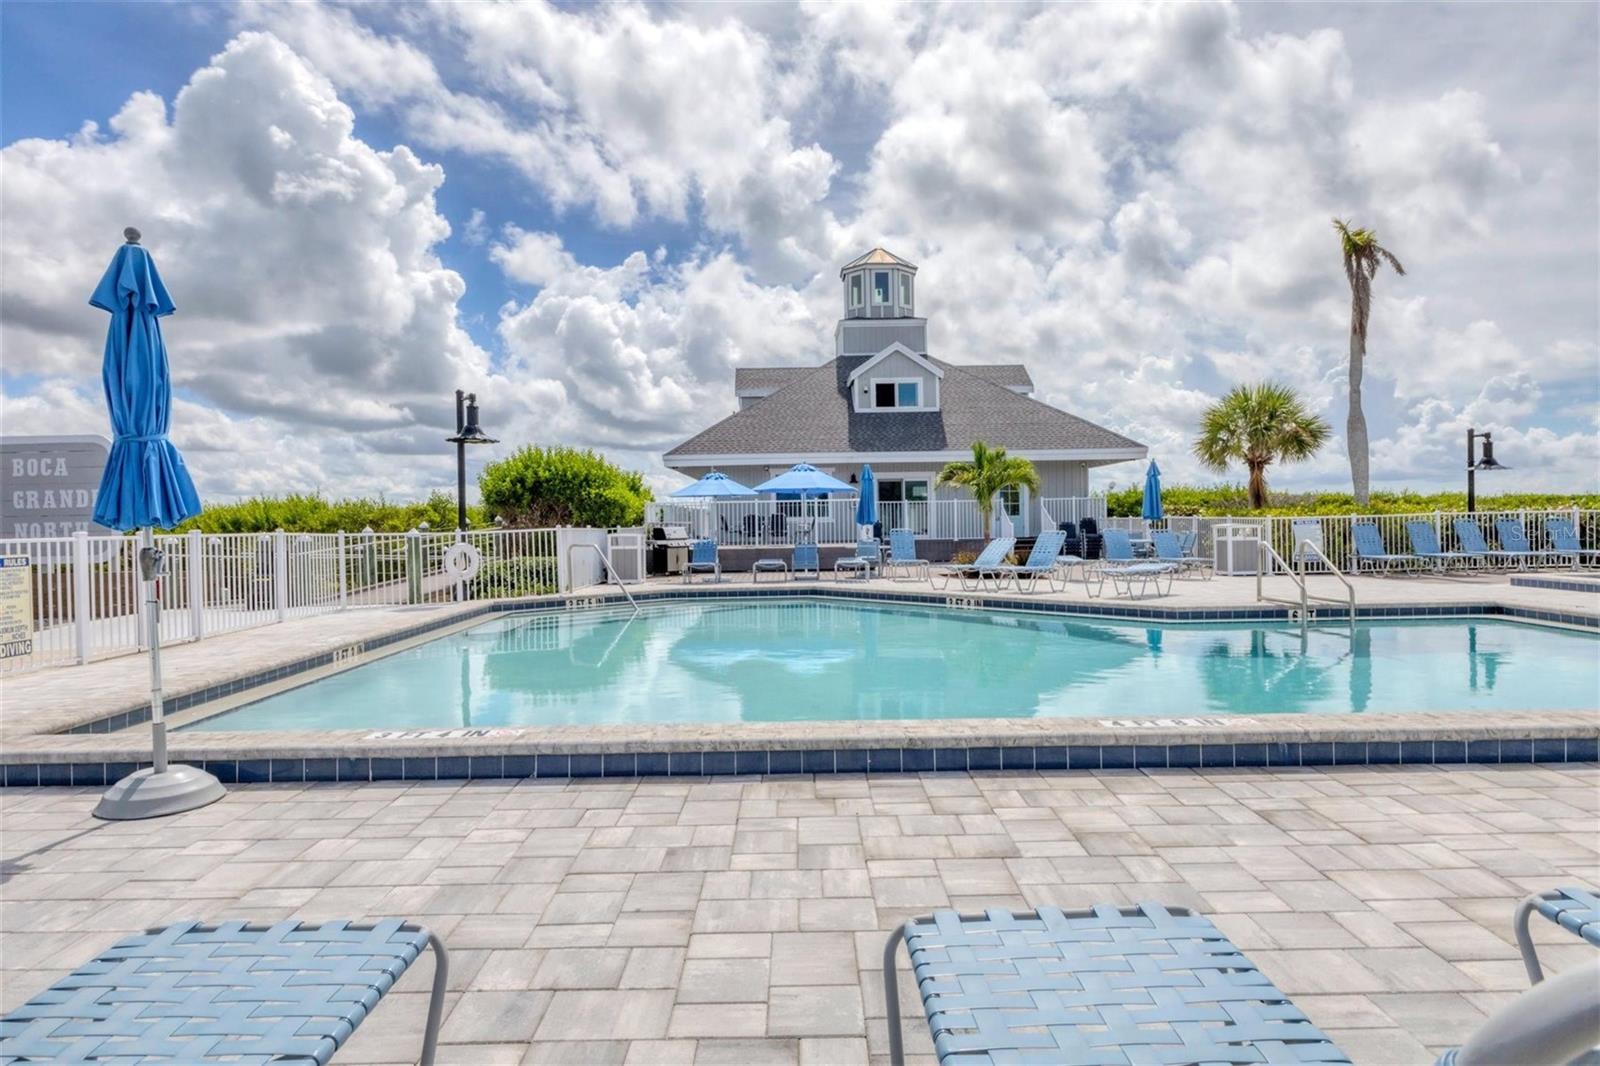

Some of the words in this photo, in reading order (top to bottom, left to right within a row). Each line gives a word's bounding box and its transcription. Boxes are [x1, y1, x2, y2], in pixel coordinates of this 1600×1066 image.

[12, 458, 68, 477] BOCA
[0, 640, 31, 658] DIVING
[461, 730, 491, 738] IN
